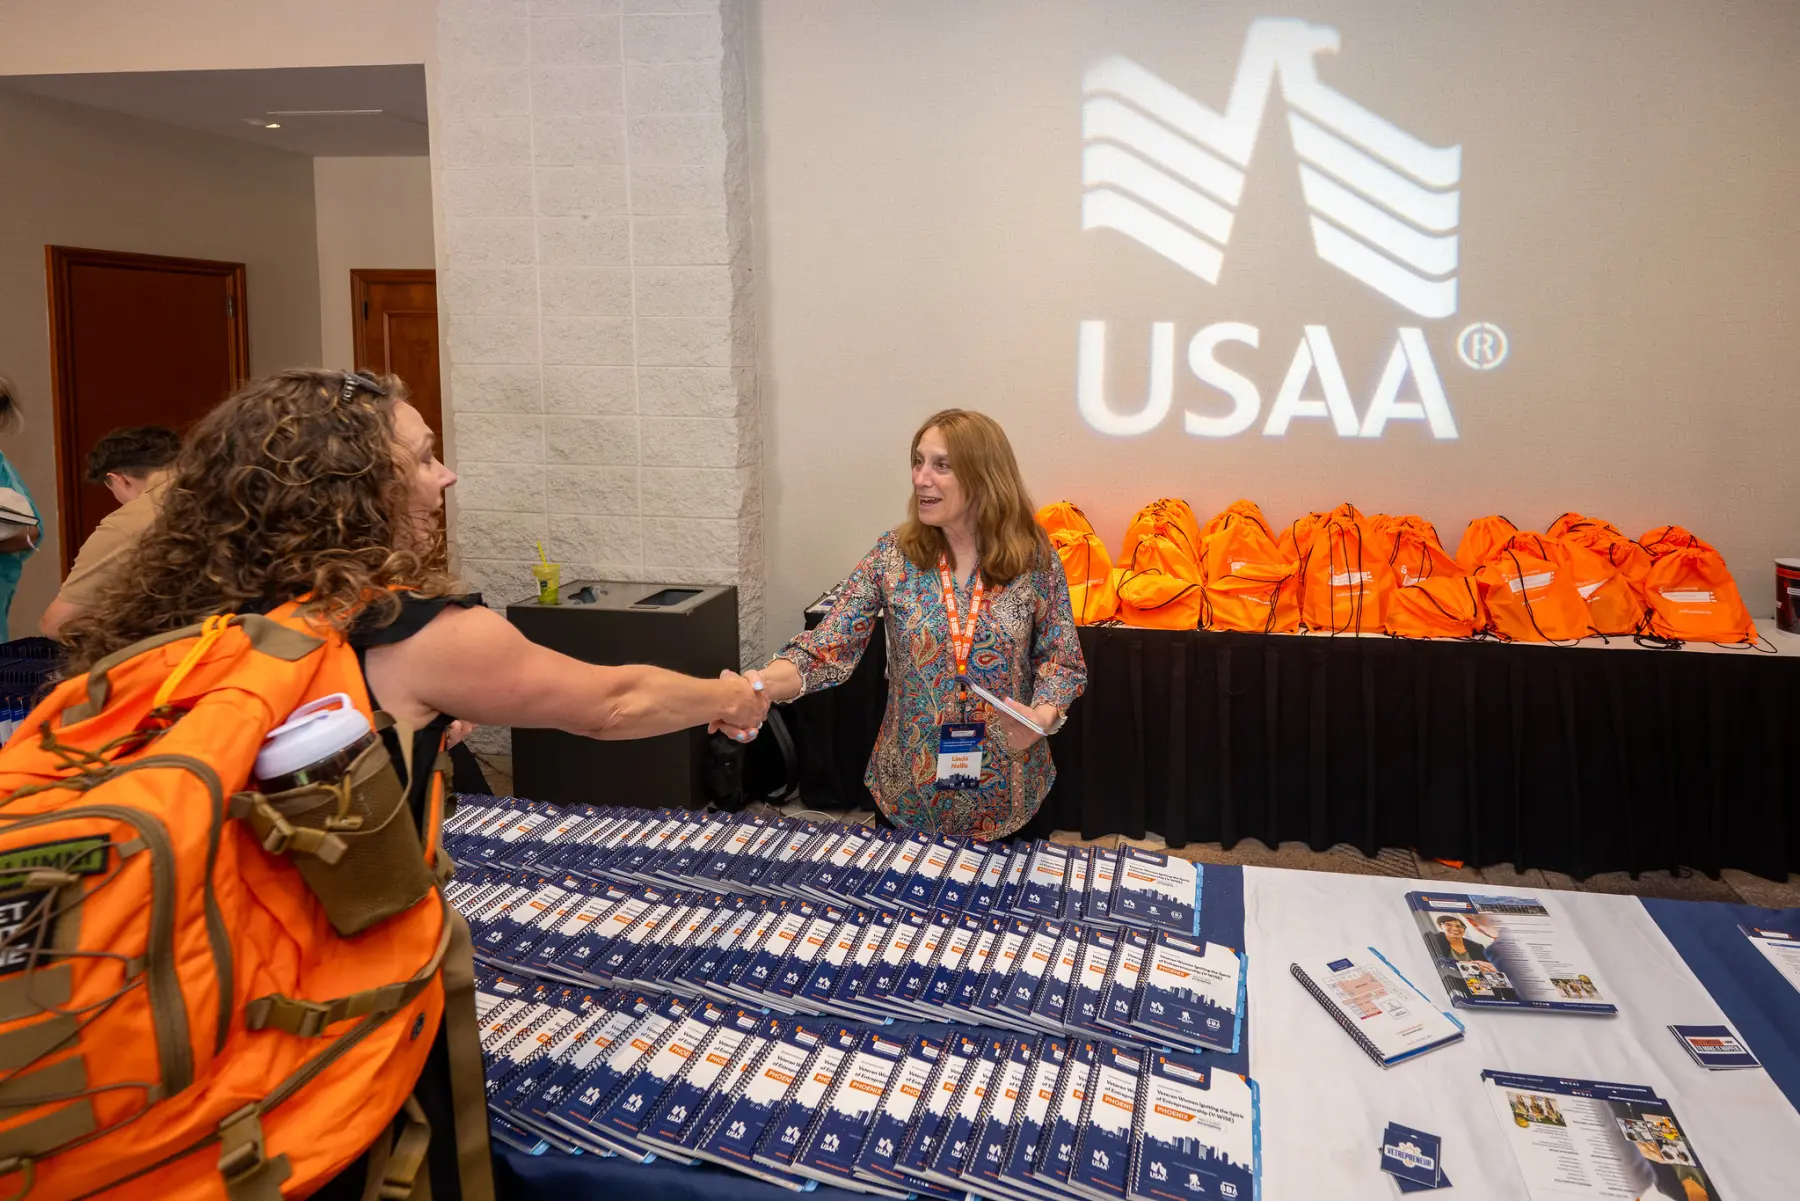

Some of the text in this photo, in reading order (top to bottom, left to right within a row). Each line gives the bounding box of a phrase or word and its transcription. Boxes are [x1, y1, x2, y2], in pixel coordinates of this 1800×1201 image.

[1077, 320, 1458, 439] USAA
[852, 1081, 882, 1095] PHOENIX
[1157, 1106, 1189, 1121] PHOENIX
[1387, 1147, 1432, 1167] VETREPRENEUR
